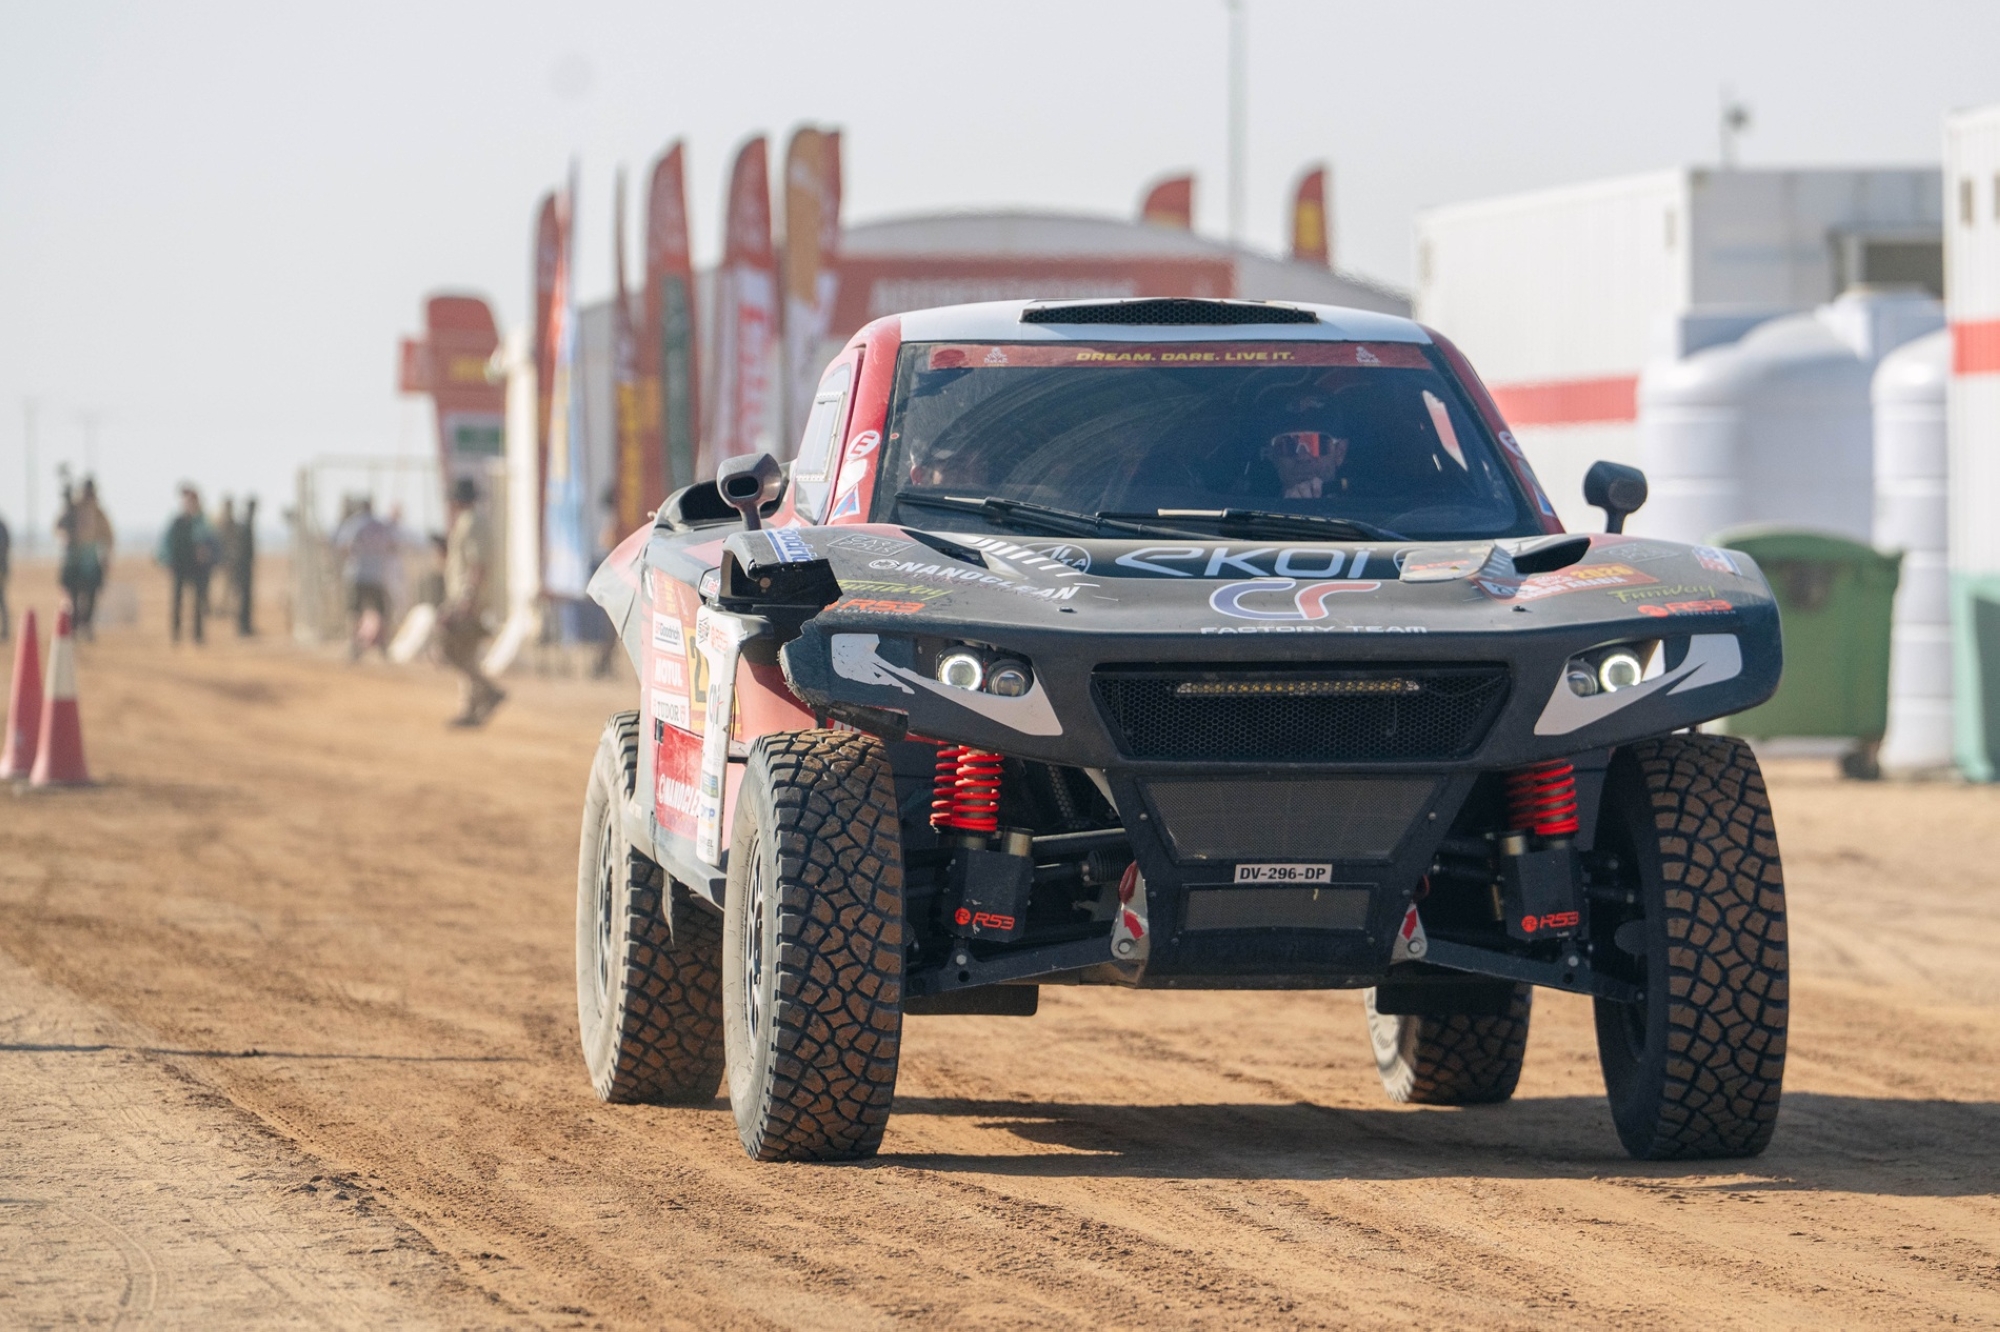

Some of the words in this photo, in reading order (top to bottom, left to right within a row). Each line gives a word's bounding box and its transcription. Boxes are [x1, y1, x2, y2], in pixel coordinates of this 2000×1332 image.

[1076, 352, 1156, 362] DREAM.
[1160, 352, 1219, 362] DARE.
[1225, 352, 1268, 361] LIVE
[1272, 351, 1296, 360] IT.
[896, 561, 1081, 600] NANOCLEAN
[1200, 626, 1335, 635] FACTORY
[1346, 625, 1427, 634] TEAM
[1240, 867, 1326, 880] DV-296-DP
